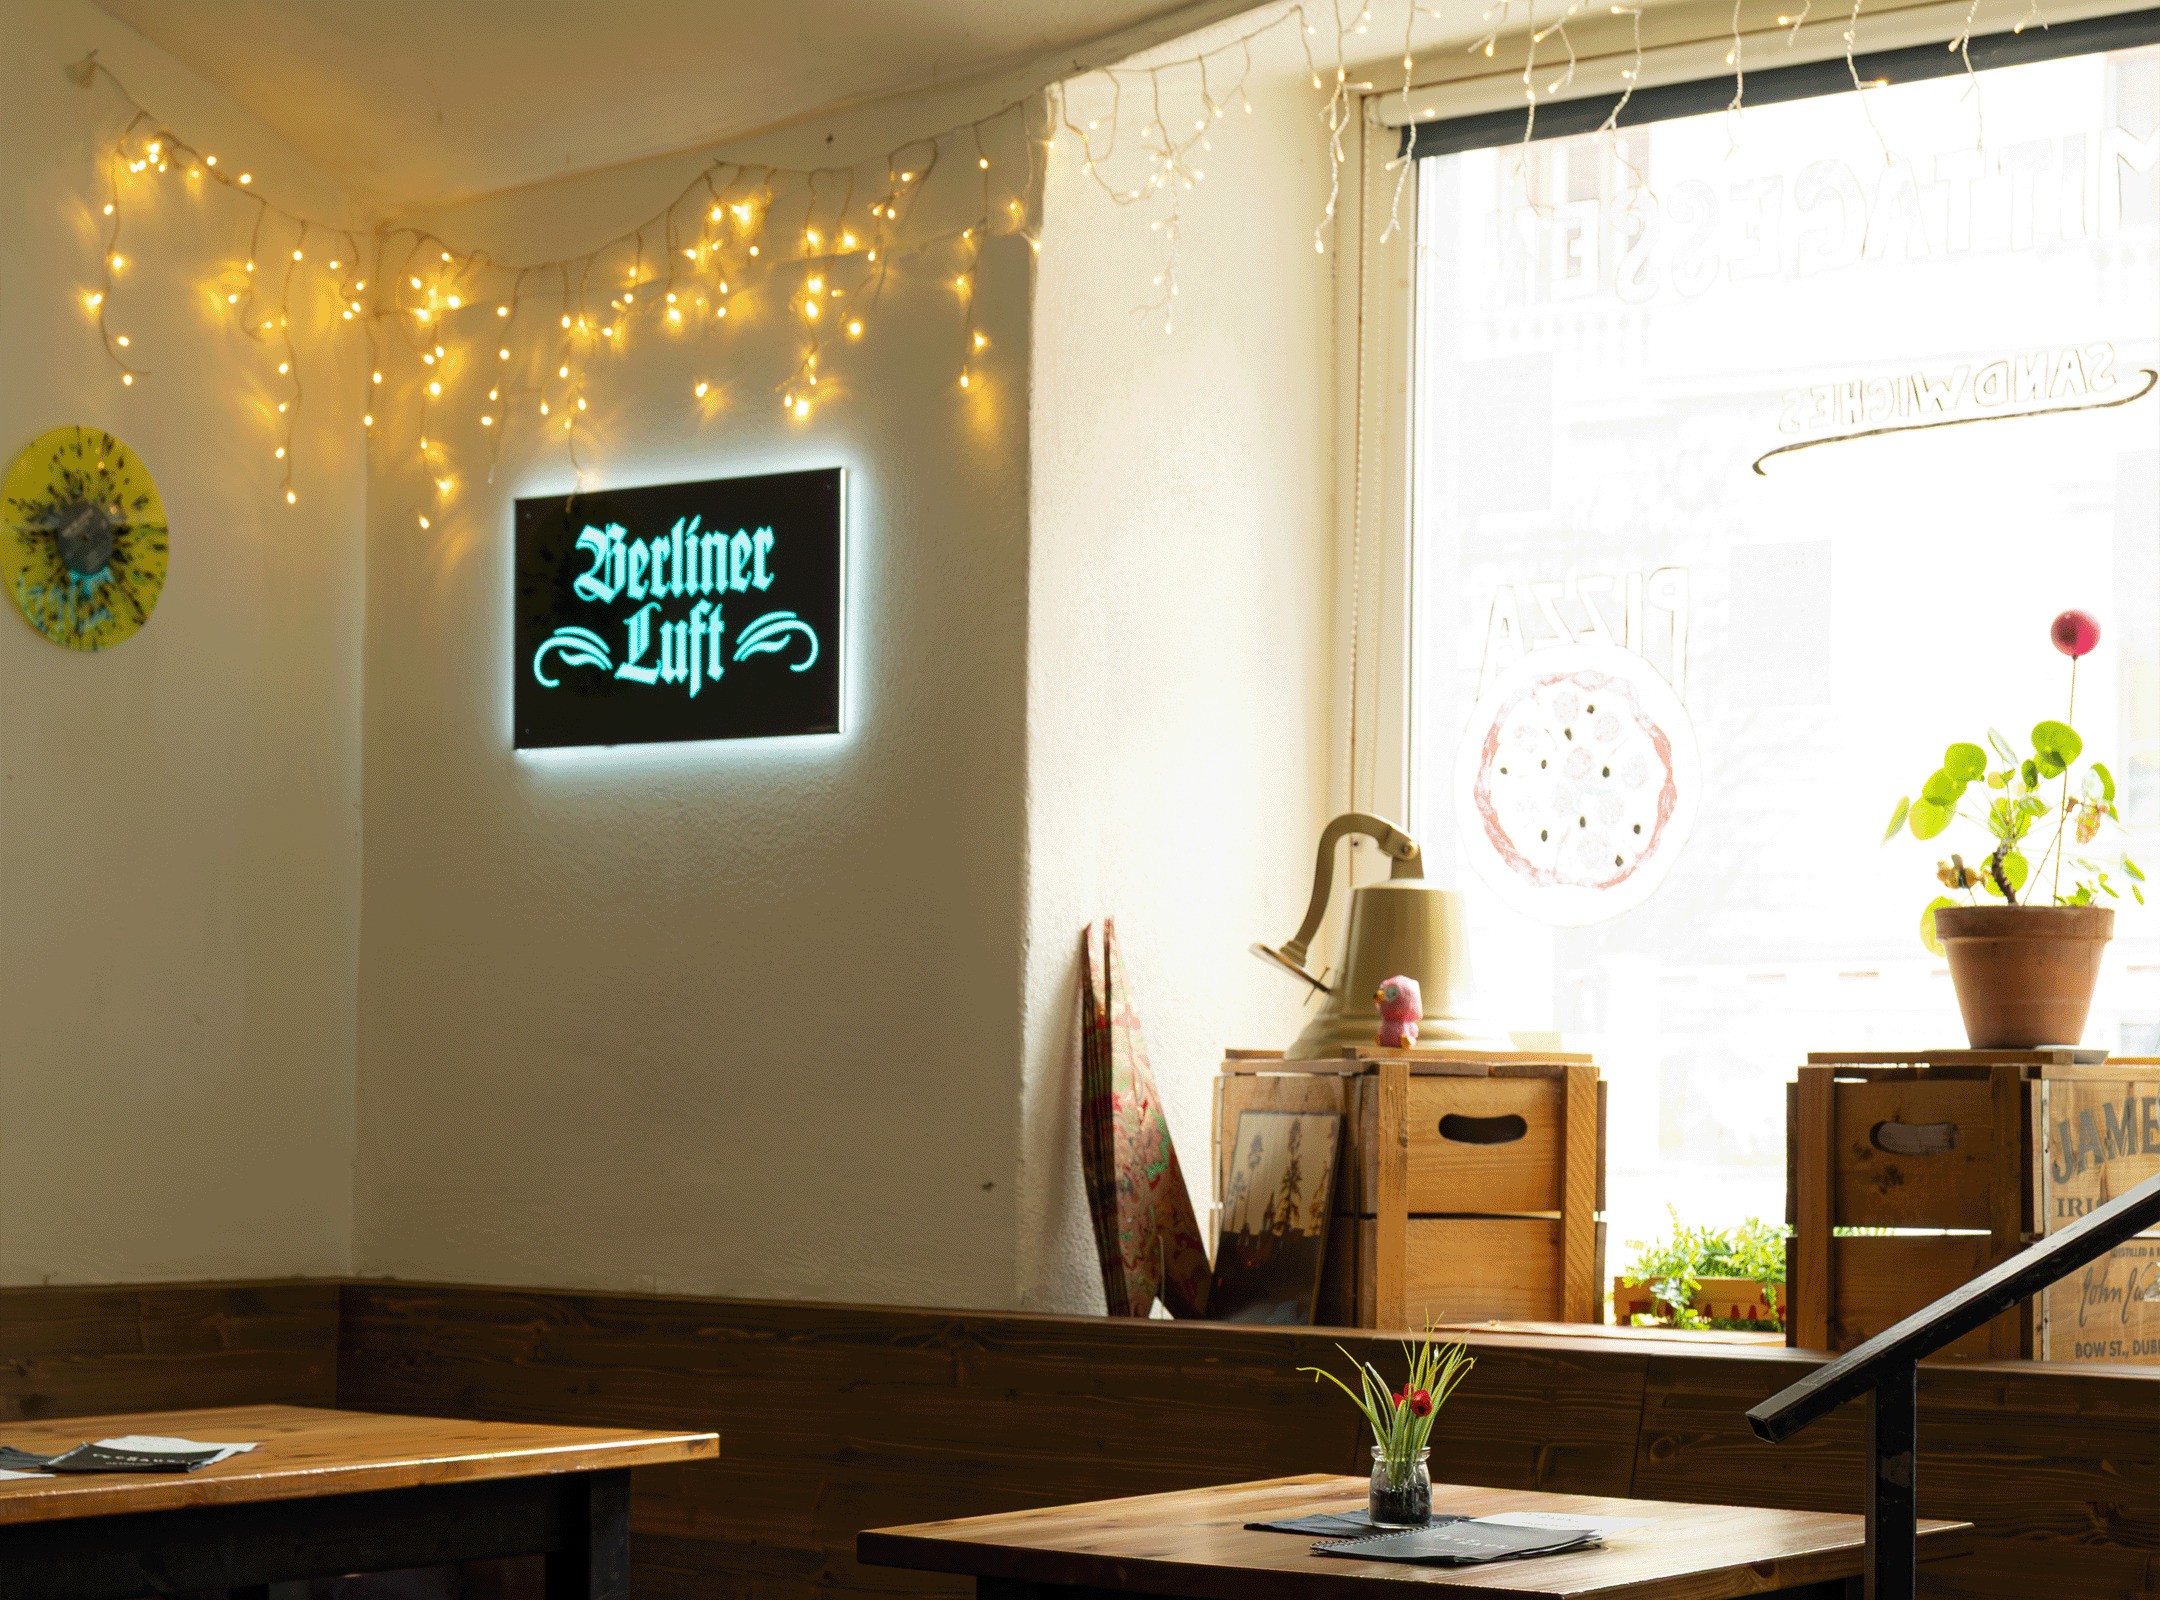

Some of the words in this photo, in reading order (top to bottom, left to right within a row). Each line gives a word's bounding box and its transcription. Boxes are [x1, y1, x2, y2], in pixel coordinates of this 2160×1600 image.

[573, 514, 775, 604] Berliner
[614, 599, 725, 698] Luft
[2079, 1266, 2121, 1328] John
[2075, 1341, 2106, 1359] BOW
